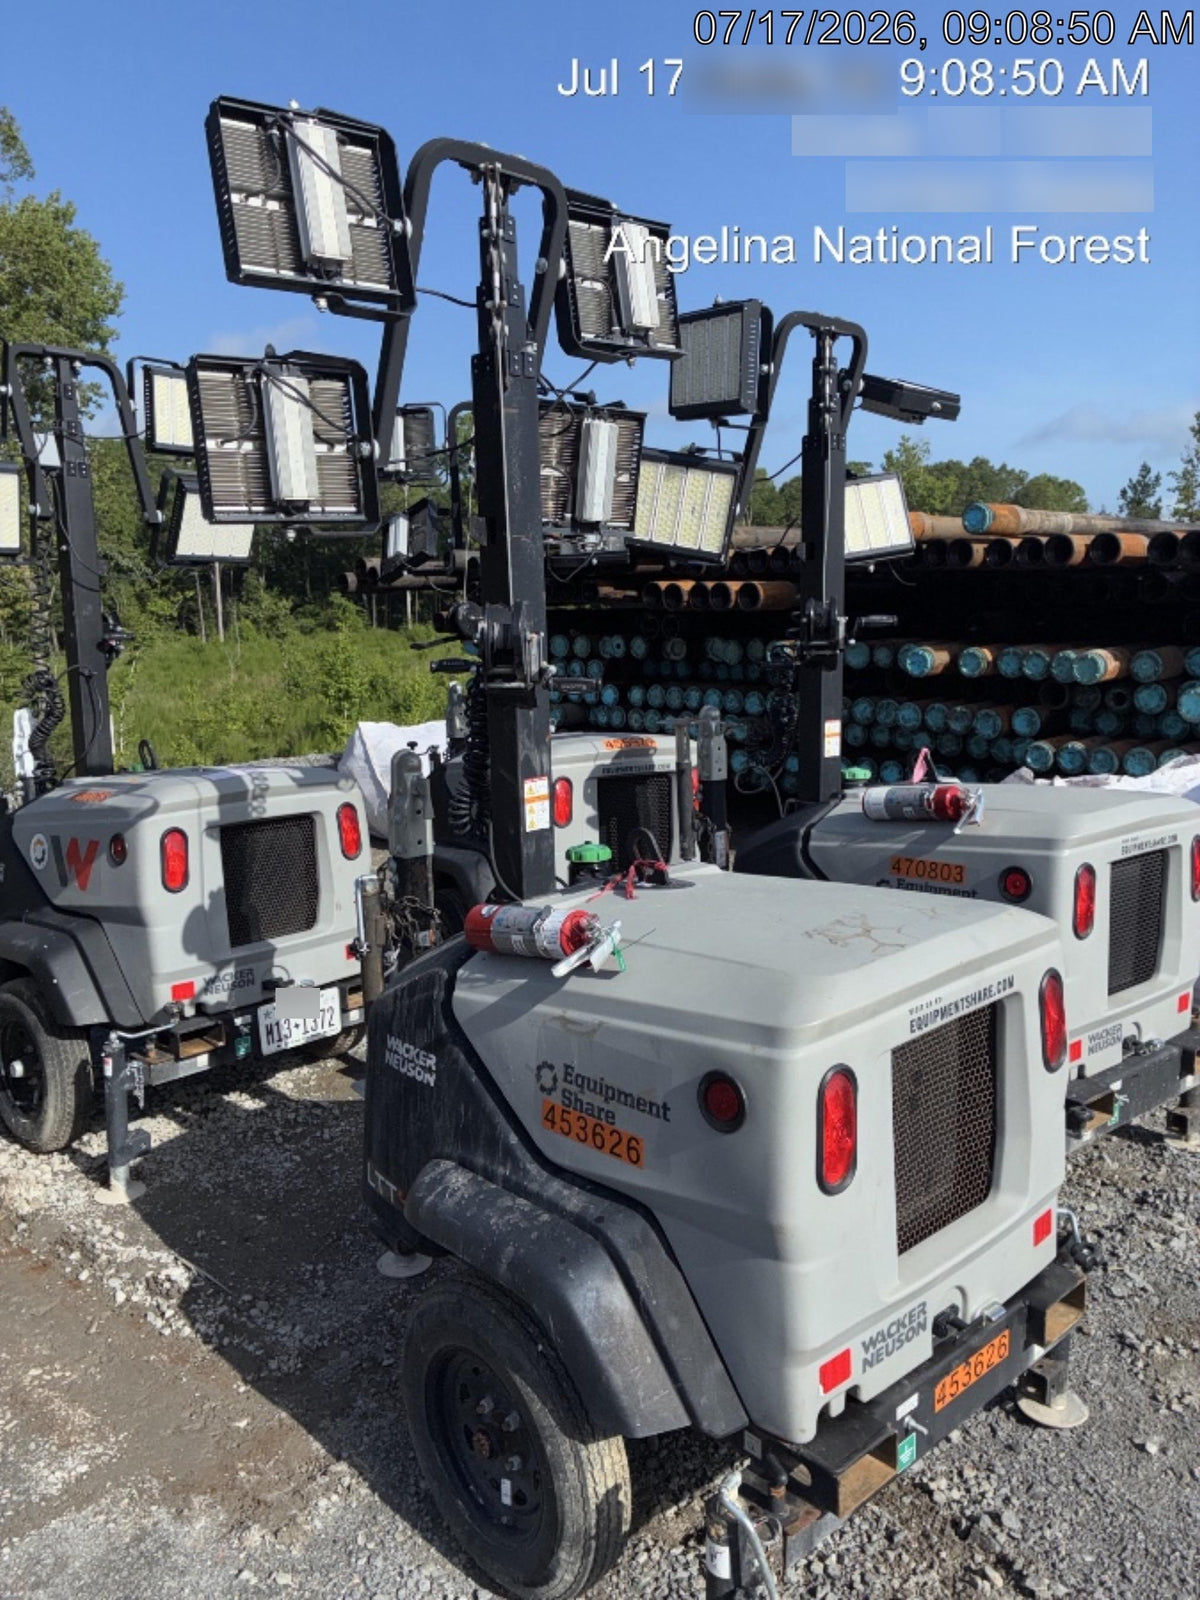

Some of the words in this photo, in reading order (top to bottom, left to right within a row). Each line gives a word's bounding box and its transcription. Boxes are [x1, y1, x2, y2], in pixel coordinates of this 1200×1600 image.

[892, 857, 964, 883] 470803
[909, 974, 1014, 1033] EQUIPMENTSHARE.COM
[385, 1049, 436, 1087] NEUSON
[386, 1033, 436, 1071] WACKER
[561, 1087, 616, 1126] Share
[562, 1062, 671, 1122] Equipment
[543, 1103, 641, 1166] 453626
[861, 1301, 927, 1355] WACKER
[861, 1316, 927, 1375] NEUSON
[936, 1334, 1007, 1406] 453626
